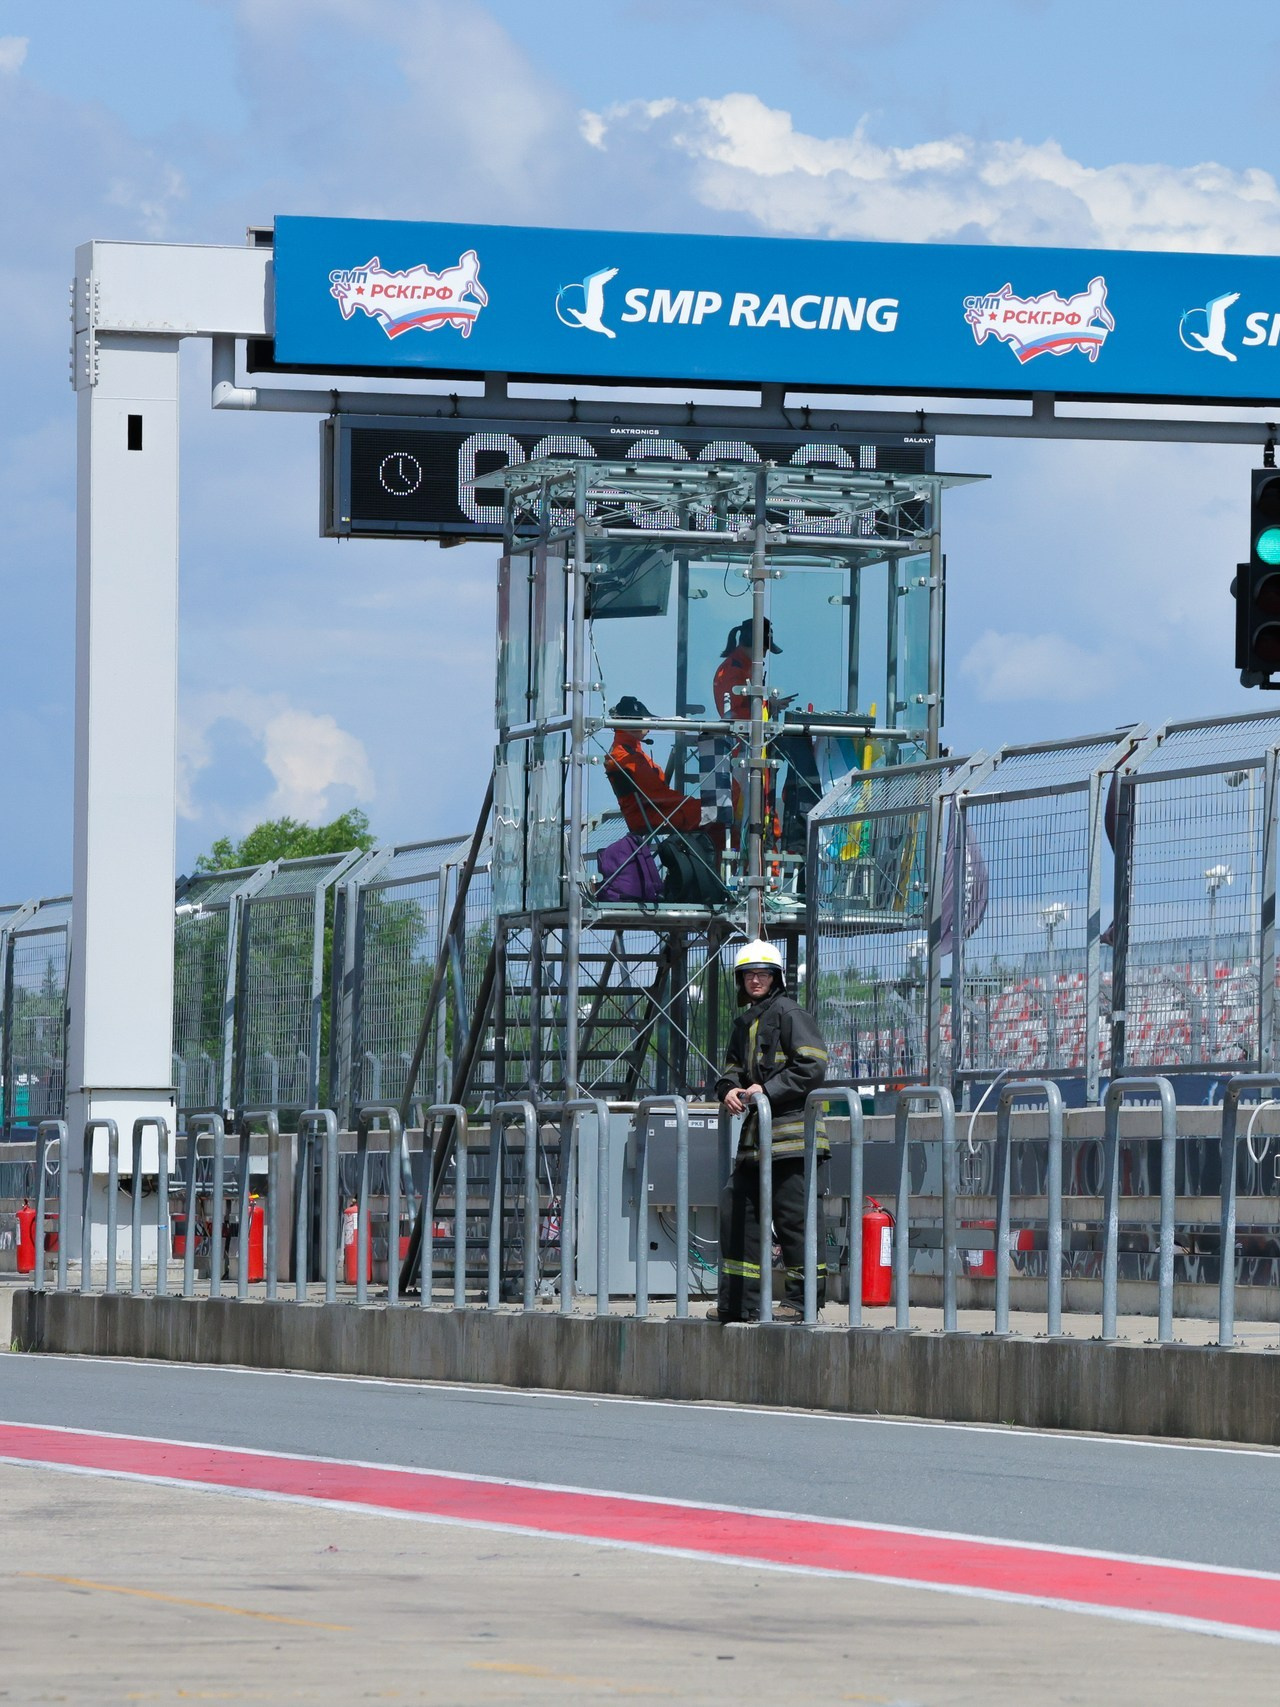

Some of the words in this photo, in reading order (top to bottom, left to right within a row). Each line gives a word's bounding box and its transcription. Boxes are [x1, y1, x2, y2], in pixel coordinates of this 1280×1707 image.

[330, 270, 368, 284] СМП
[370, 284, 453, 300] РСКГ.РФ
[621, 288, 722, 325] SMP
[728, 292, 899, 332] RACING
[964, 296, 1001, 310] СМП
[1002, 310, 1082, 325] РСКГ.РФ
